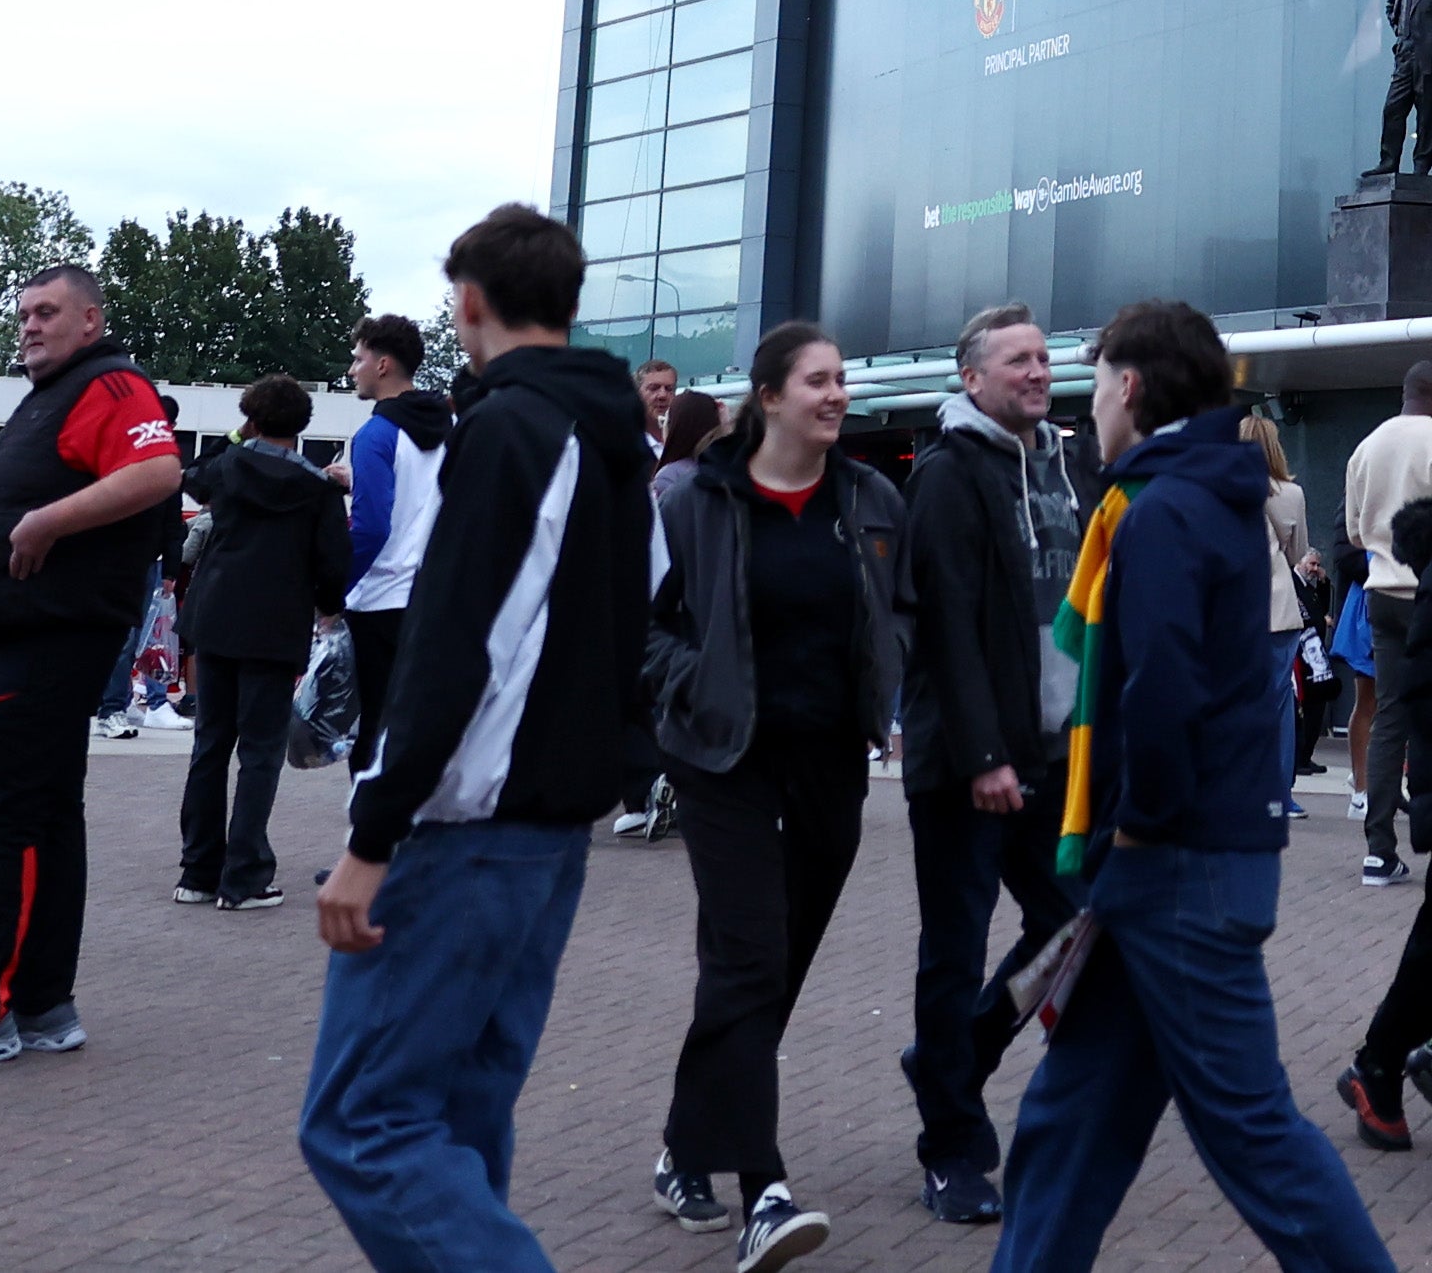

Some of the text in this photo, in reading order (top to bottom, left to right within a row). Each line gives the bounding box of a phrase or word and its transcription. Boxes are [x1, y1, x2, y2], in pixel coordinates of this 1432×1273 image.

[984, 33, 1070, 77] PRINCIPAL PARTNER
[924, 205, 940, 229] bet
[941, 201, 957, 225] the
[958, 188, 1013, 224] responsible
[1013, 187, 1037, 215] way
[1050, 168, 1143, 205] GambleAware.org
